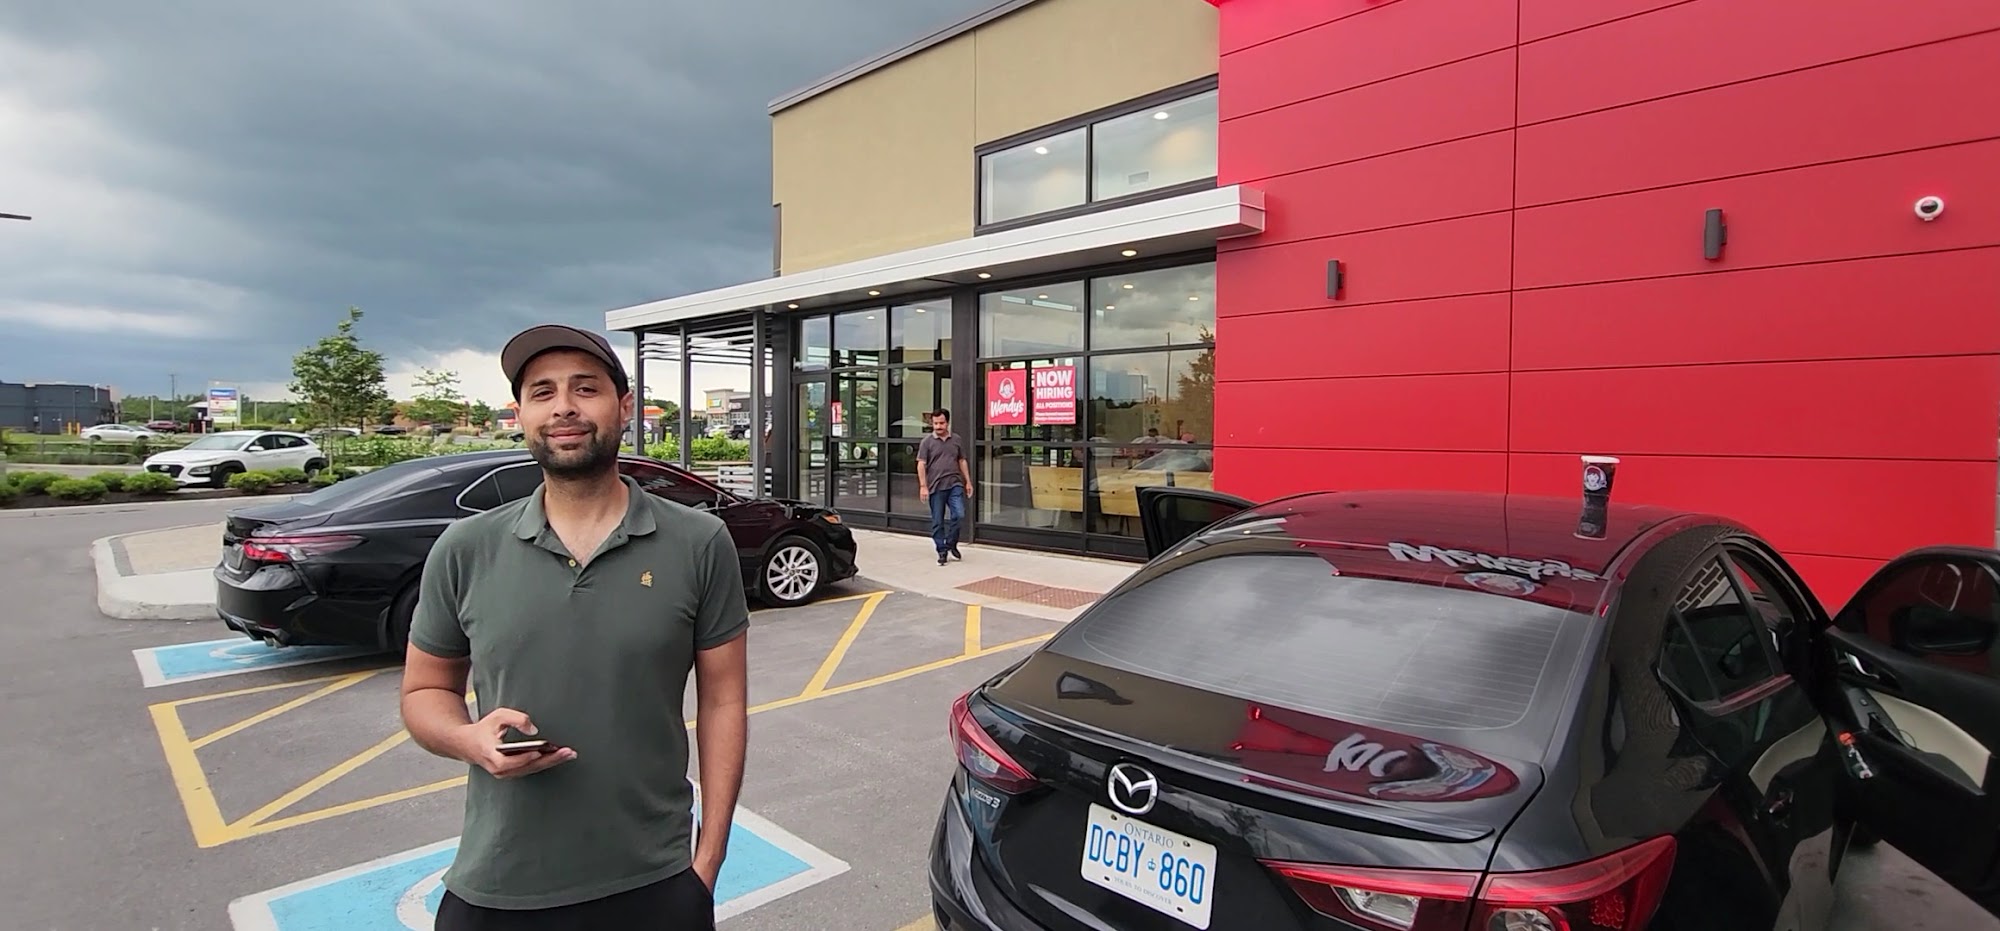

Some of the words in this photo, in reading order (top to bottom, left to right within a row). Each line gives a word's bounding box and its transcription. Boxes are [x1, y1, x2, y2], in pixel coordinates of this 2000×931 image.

[1037, 370, 1073, 387] NOW
[1036, 387, 1073, 399] HIRING
[990, 397, 1025, 418] Wendy's
[1036, 402, 1046, 410] ALL
[1089, 824, 1145, 878] DCBY
[1160, 852, 1205, 905] 860
